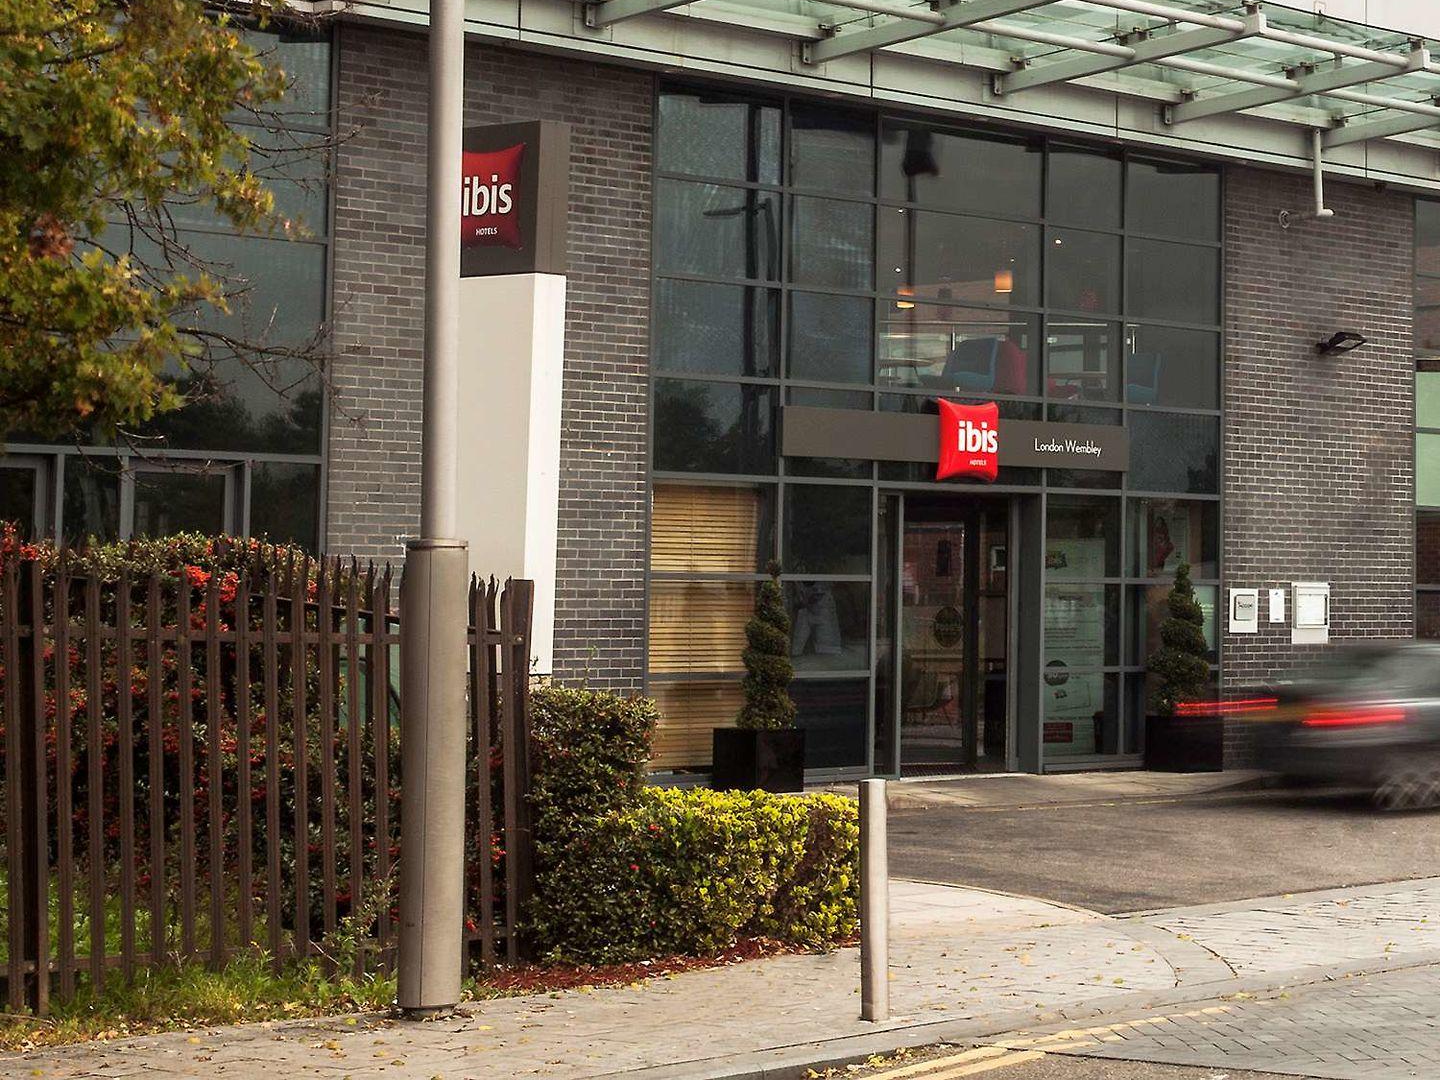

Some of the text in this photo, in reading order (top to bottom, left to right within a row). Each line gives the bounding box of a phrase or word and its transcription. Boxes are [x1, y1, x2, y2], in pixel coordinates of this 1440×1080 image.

[462, 174, 513, 217] ibis
[475, 227, 498, 236] HOTELS
[958, 420, 998, 453] ibis
[1034, 437, 1102, 458] London Wembley
